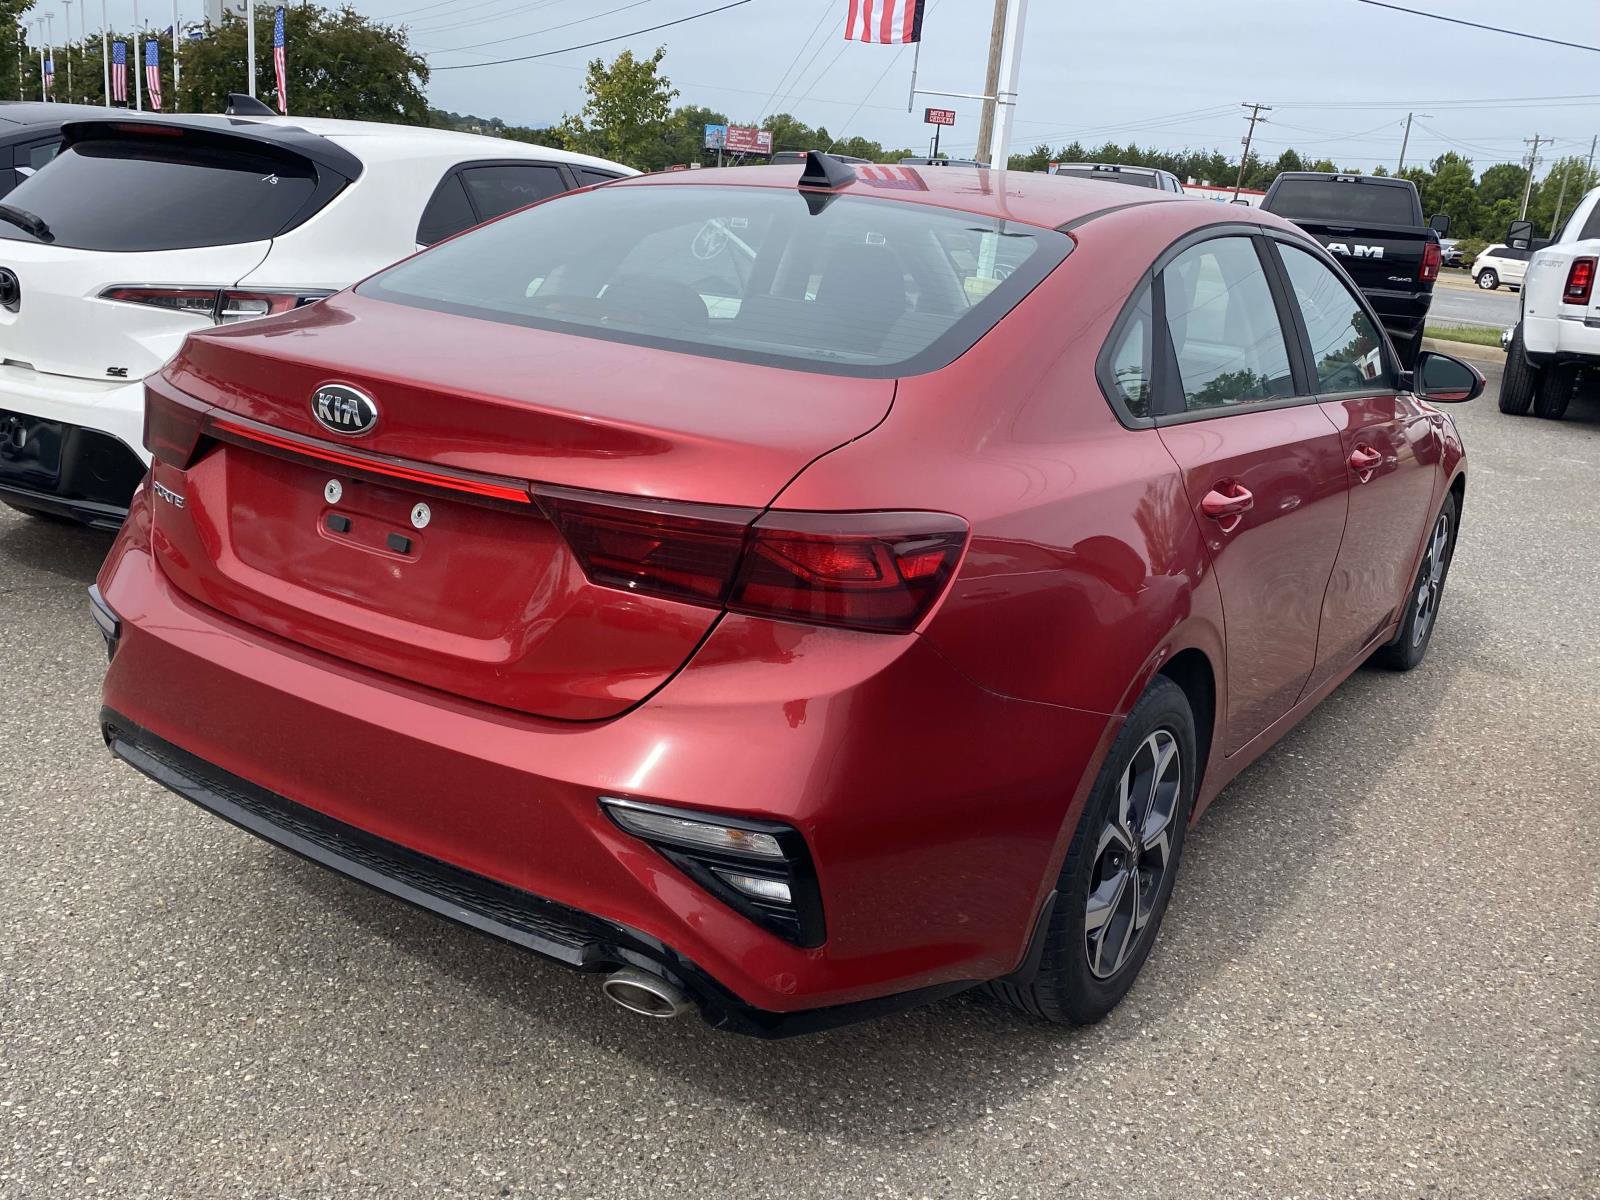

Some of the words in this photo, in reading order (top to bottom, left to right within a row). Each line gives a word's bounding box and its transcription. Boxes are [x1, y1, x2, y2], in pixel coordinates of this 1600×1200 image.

[929, 115, 954, 124] CHICKEN
[1327, 242, 1385, 259] AM
[105, 366, 129, 378] SE
[318, 392, 363, 427] KIA
